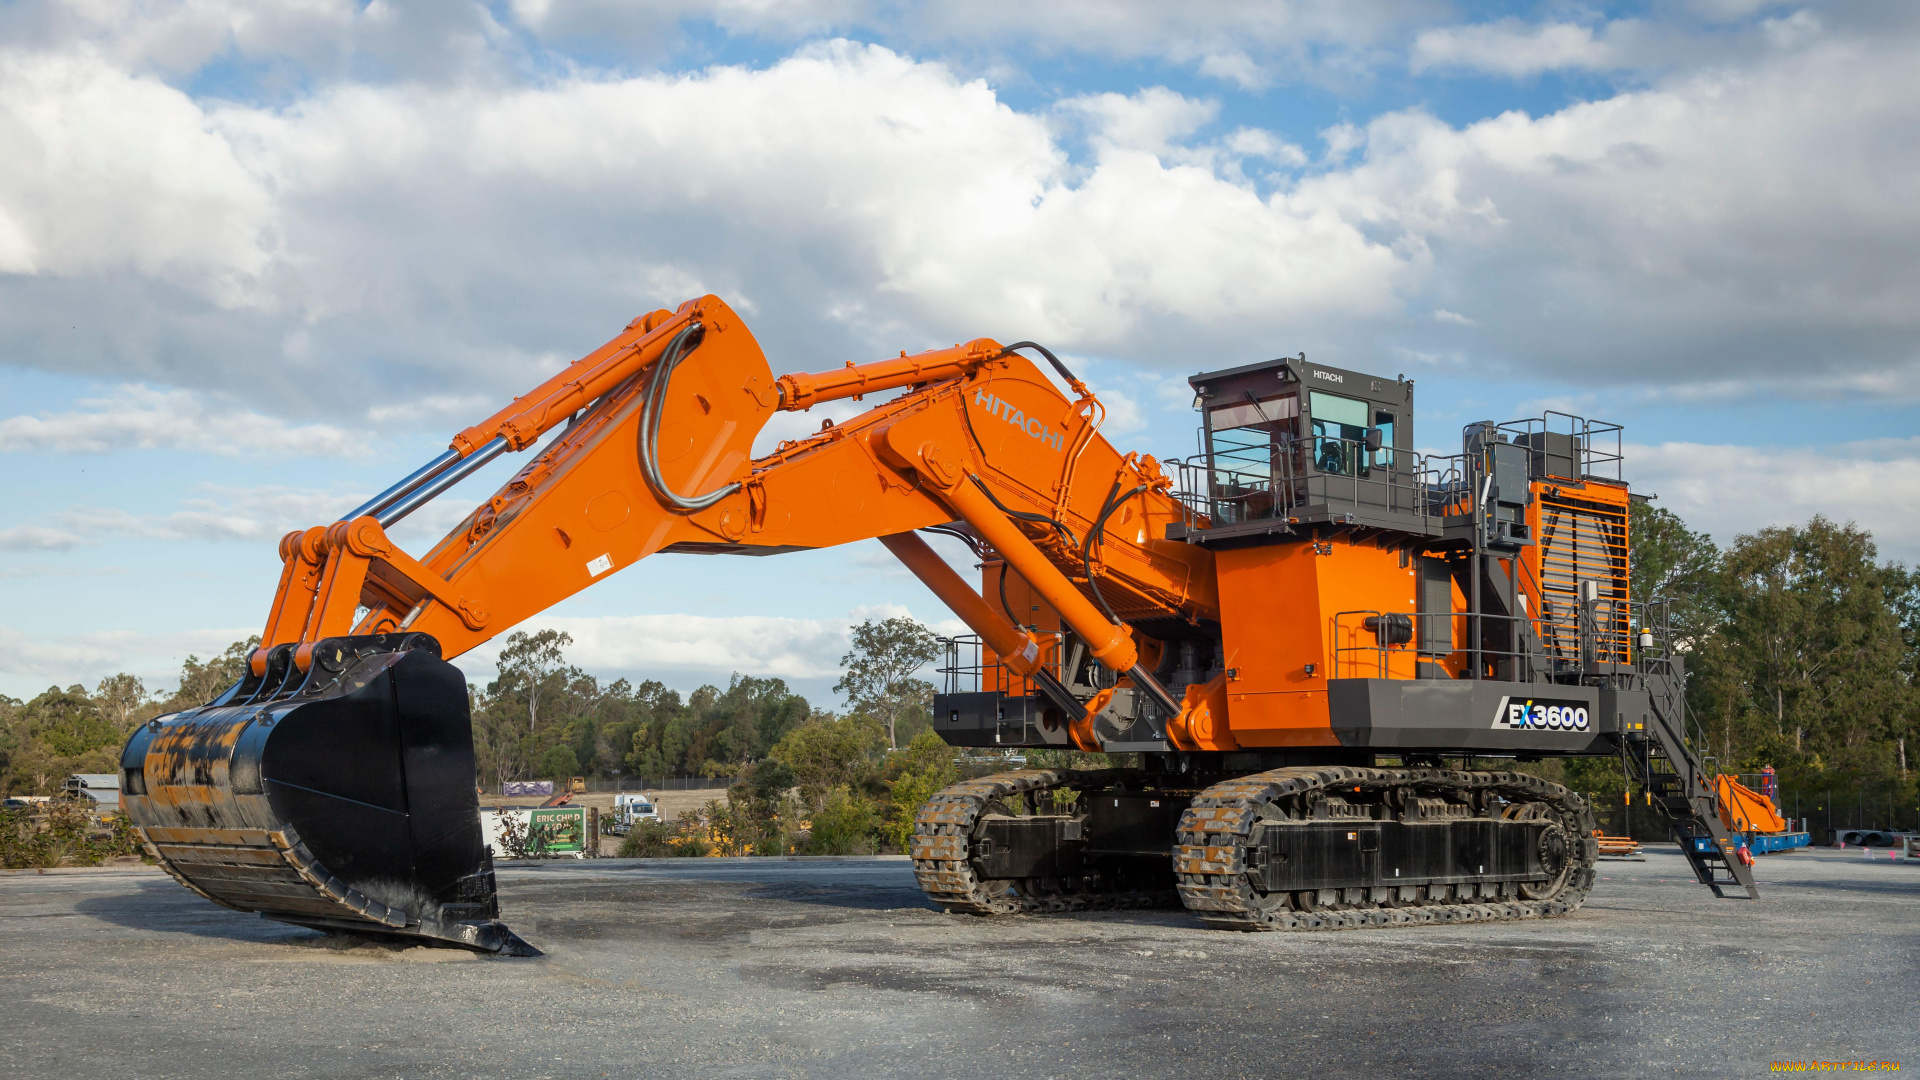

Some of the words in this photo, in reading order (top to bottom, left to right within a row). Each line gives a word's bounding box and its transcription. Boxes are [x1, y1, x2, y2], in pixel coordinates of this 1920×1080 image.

[1313, 369, 1343, 384] HITACHI
[975, 387, 1064, 452] HITACHI
[1509, 700, 1588, 731] EX3600
[536, 815, 554, 823] ERIC
